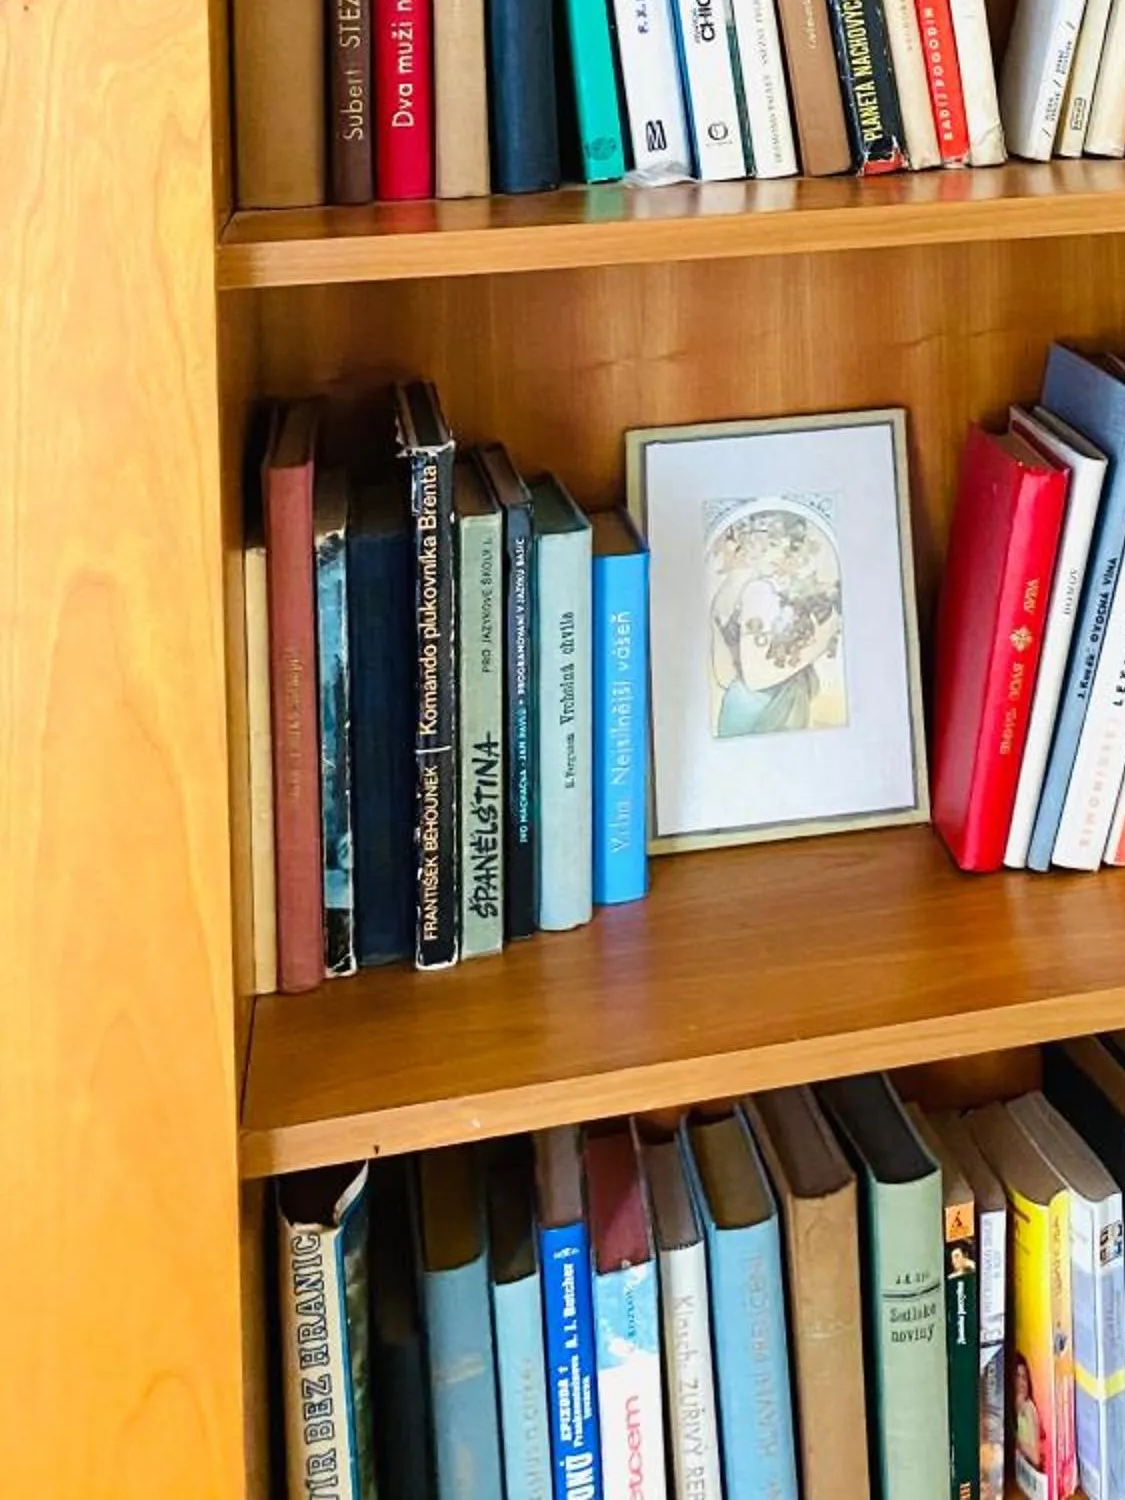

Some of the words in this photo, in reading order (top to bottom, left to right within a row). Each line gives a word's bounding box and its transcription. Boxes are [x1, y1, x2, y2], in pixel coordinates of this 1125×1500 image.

[391, 21, 414, 73] muži
[637, 19, 649, 34] F.
[390, 82, 414, 126] Dva
[853, 78, 886, 142] PLANETA
[415, 463, 437, 529] Brenta
[513, 536, 525, 566] BASIC
[416, 533, 441, 638] plukovníka
[416, 643, 439, 735] Komando
[480, 648, 493, 672] PRO
[418, 763, 440, 851] BĚHOUNEK
[463, 731, 503, 918] ŠPANĚLŠTINA
[420, 854, 441, 940] FRANTIŠEK
[289, 1232, 330, 1370] HRANIC
[562, 1261, 576, 1317] Butcher
[563, 1333, 577, 1349] A.
[890, 1323, 936, 1343] noviny
[299, 1372, 335, 1444] BEZ
[676, 1377, 708, 1456] ZUŘIVÝ
[304, 1447, 340, 1500] ÍR
